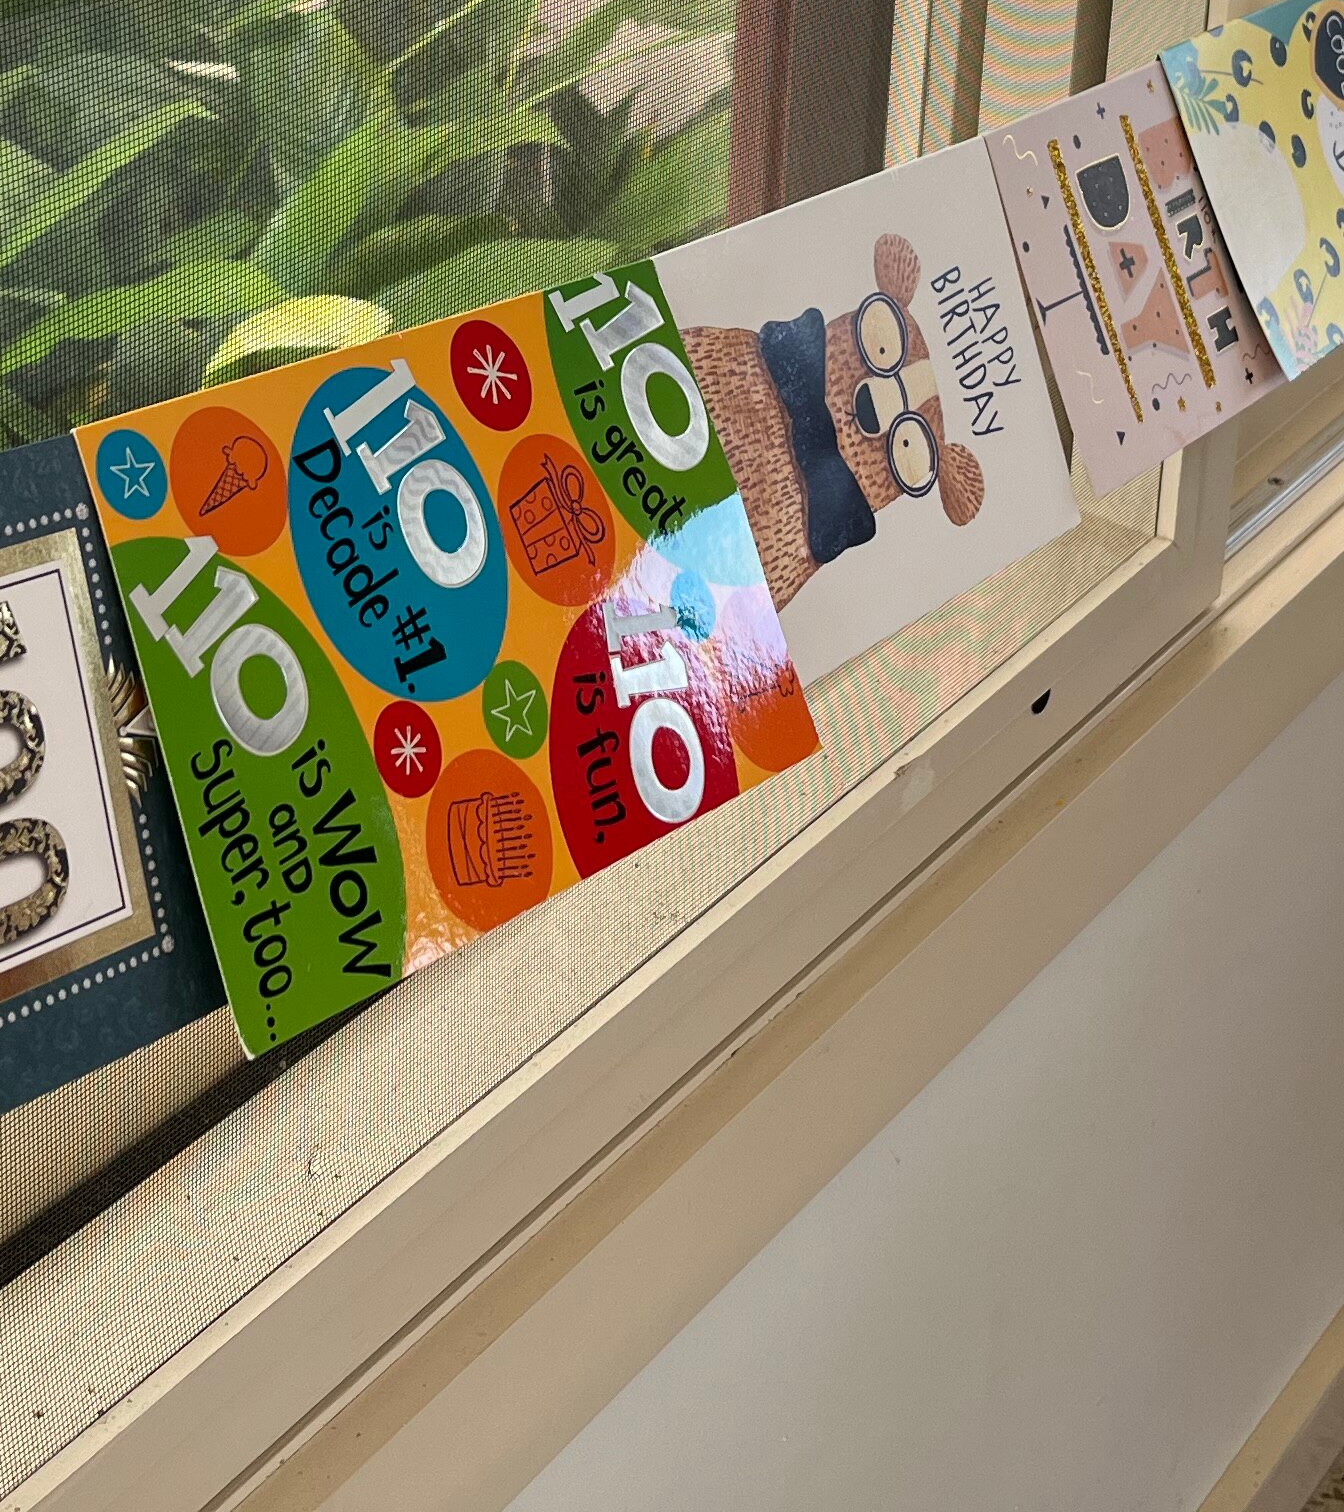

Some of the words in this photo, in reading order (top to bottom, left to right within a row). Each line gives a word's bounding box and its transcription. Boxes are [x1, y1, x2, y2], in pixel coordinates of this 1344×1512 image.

[1075, 153, 1190, 356] DAY
[1138, 116, 1239, 352] BIRTH
[549, 271, 711, 474] 110
[573, 379, 607, 423] is
[930, 266, 1004, 436] BIRTHDAY
[968, 277, 1022, 387] HAPPY
[292, 438, 391, 630] Decade
[391, 604, 448, 696] #1.
[323, 358, 488, 591] 110
[360, 503, 394, 545] is
[130, 533, 310, 758] 110
[573, 672, 603, 718] is
[602, 600, 705, 825] 110
[289, 740, 327, 798] is
[240, 905, 293, 1043] too...
